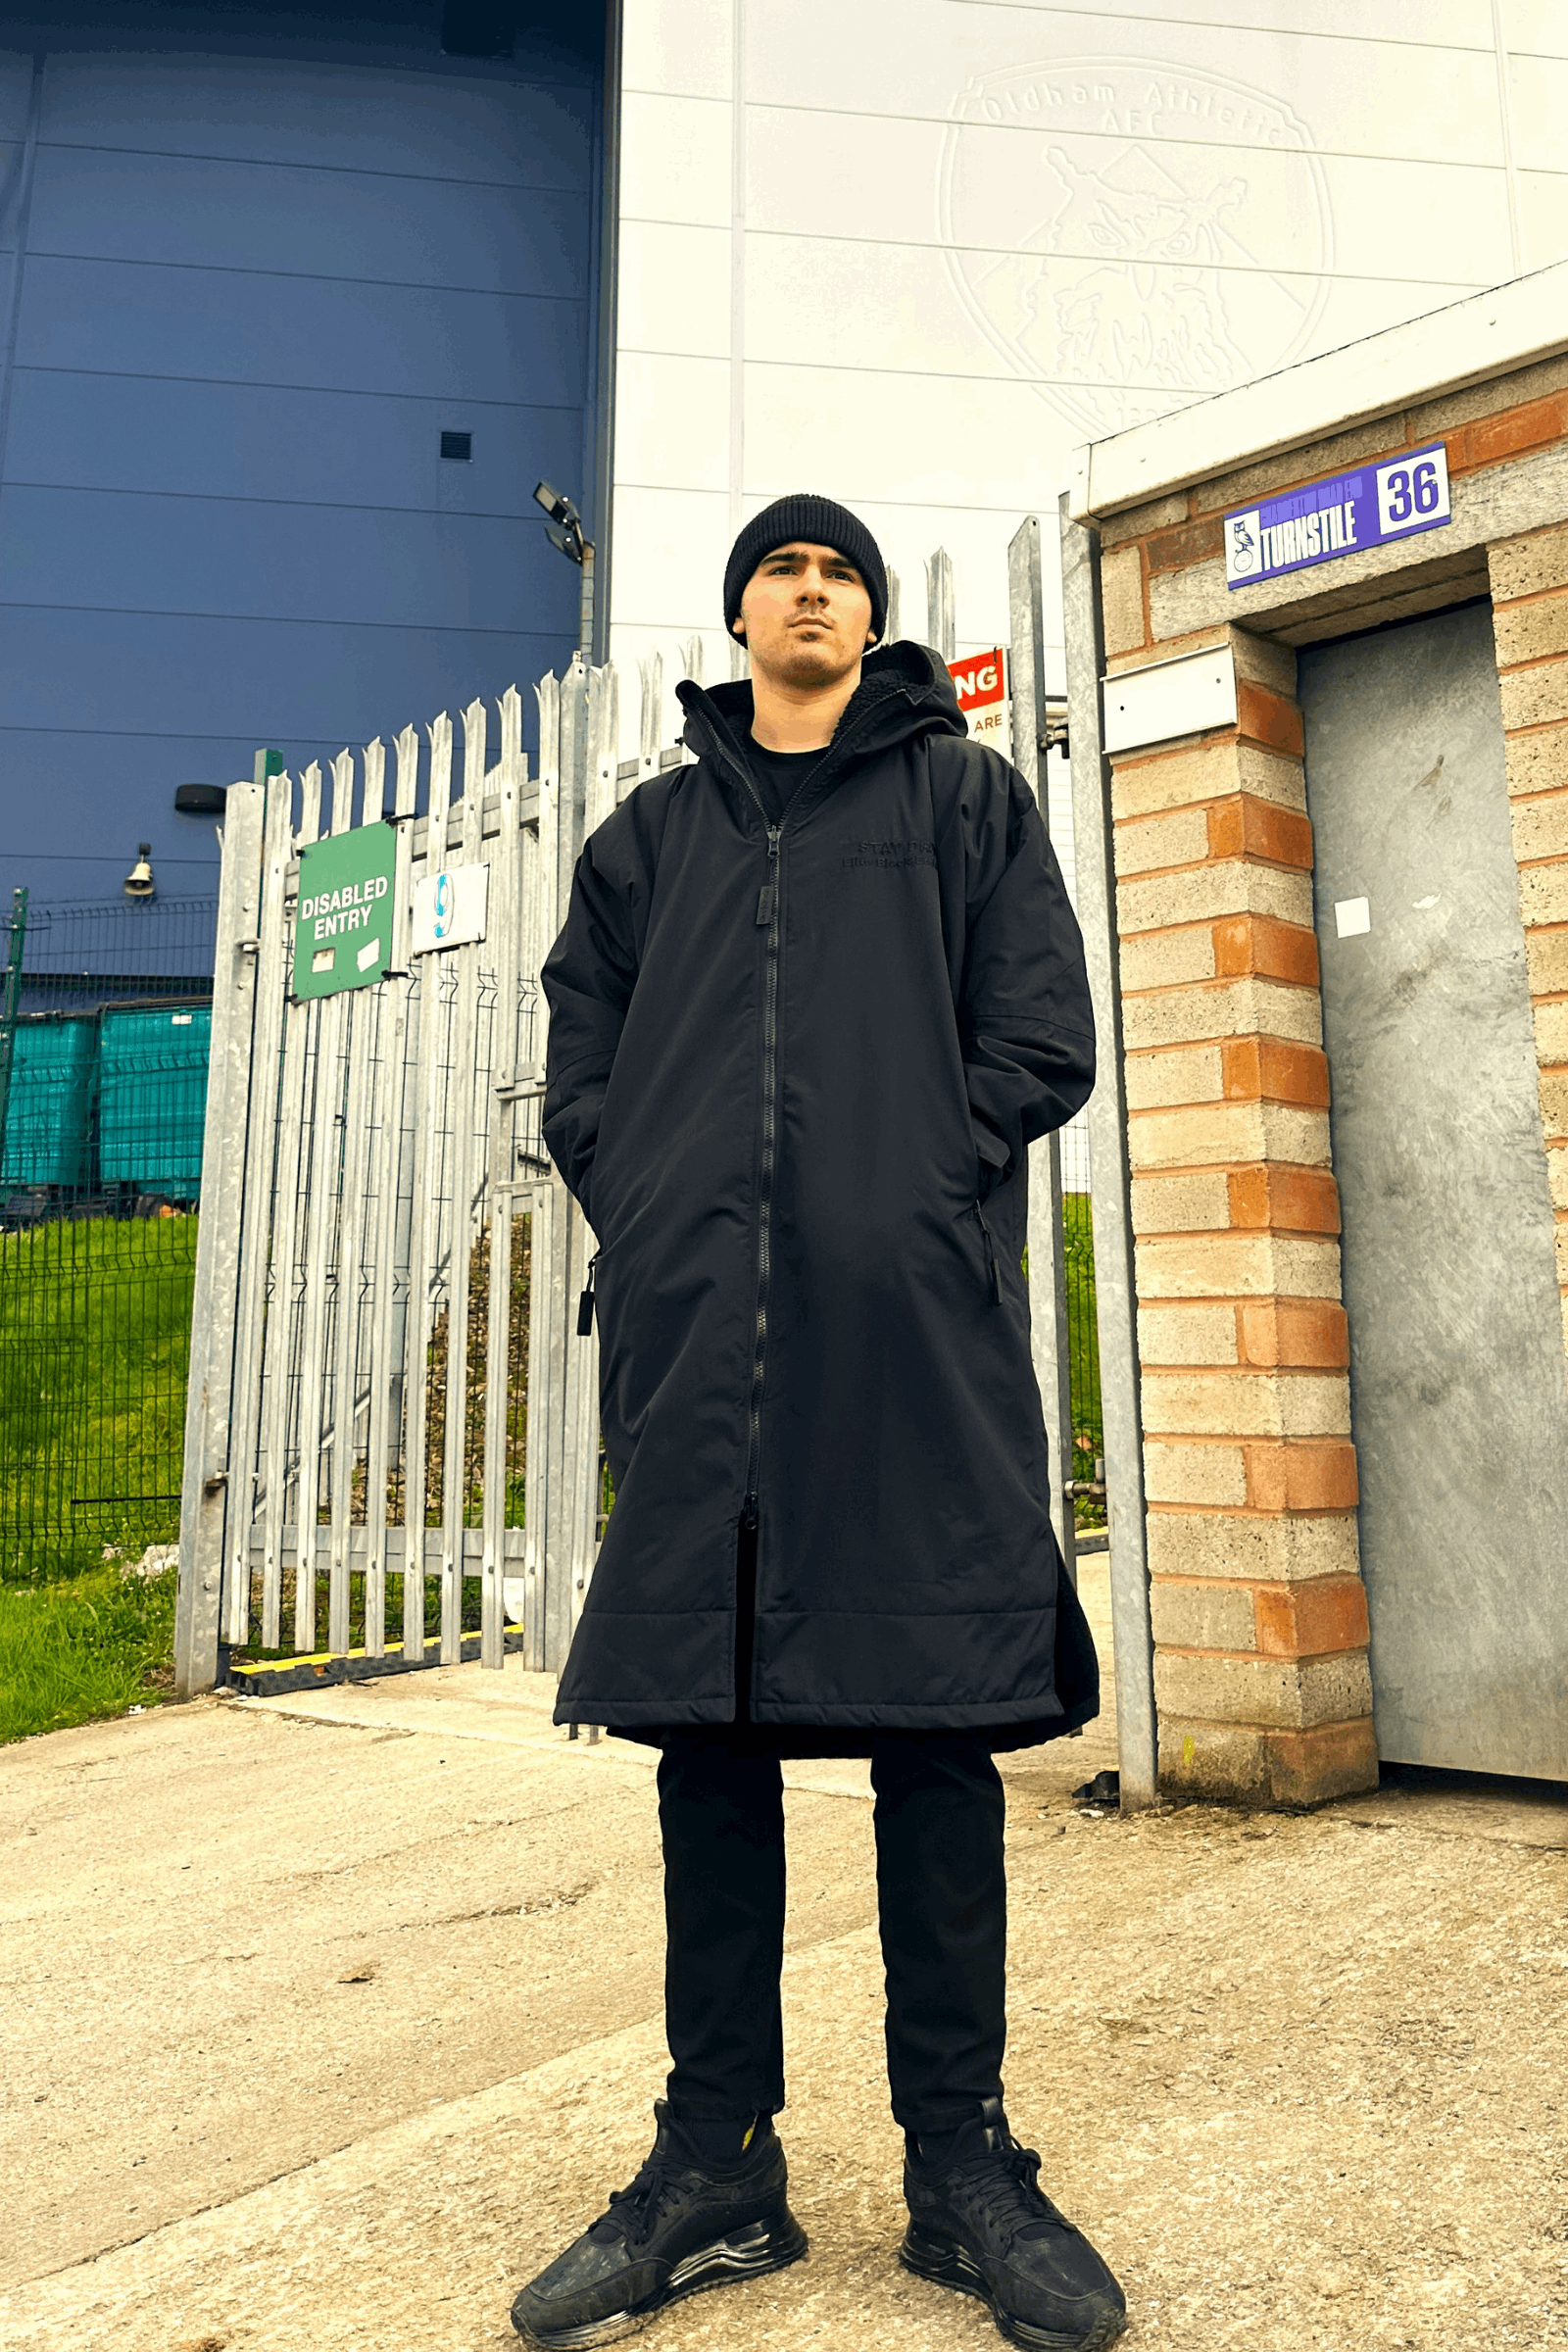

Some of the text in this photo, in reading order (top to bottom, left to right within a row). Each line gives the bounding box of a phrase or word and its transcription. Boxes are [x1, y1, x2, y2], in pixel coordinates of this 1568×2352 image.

[982, 81, 1281, 144] Oldham Athletic
[1102, 109, 1164, 135] AFC
[1260, 500, 1357, 571] TURNSTILE
[1387, 462, 1440, 522] 36
[955, 664, 999, 701] NG
[974, 713, 1003, 733] ARE
[857, 841, 903, 855] STAY
[301, 875, 388, 920] DISABLED
[433, 873, 456, 938] 9
[315, 904, 373, 941] ENTRY
